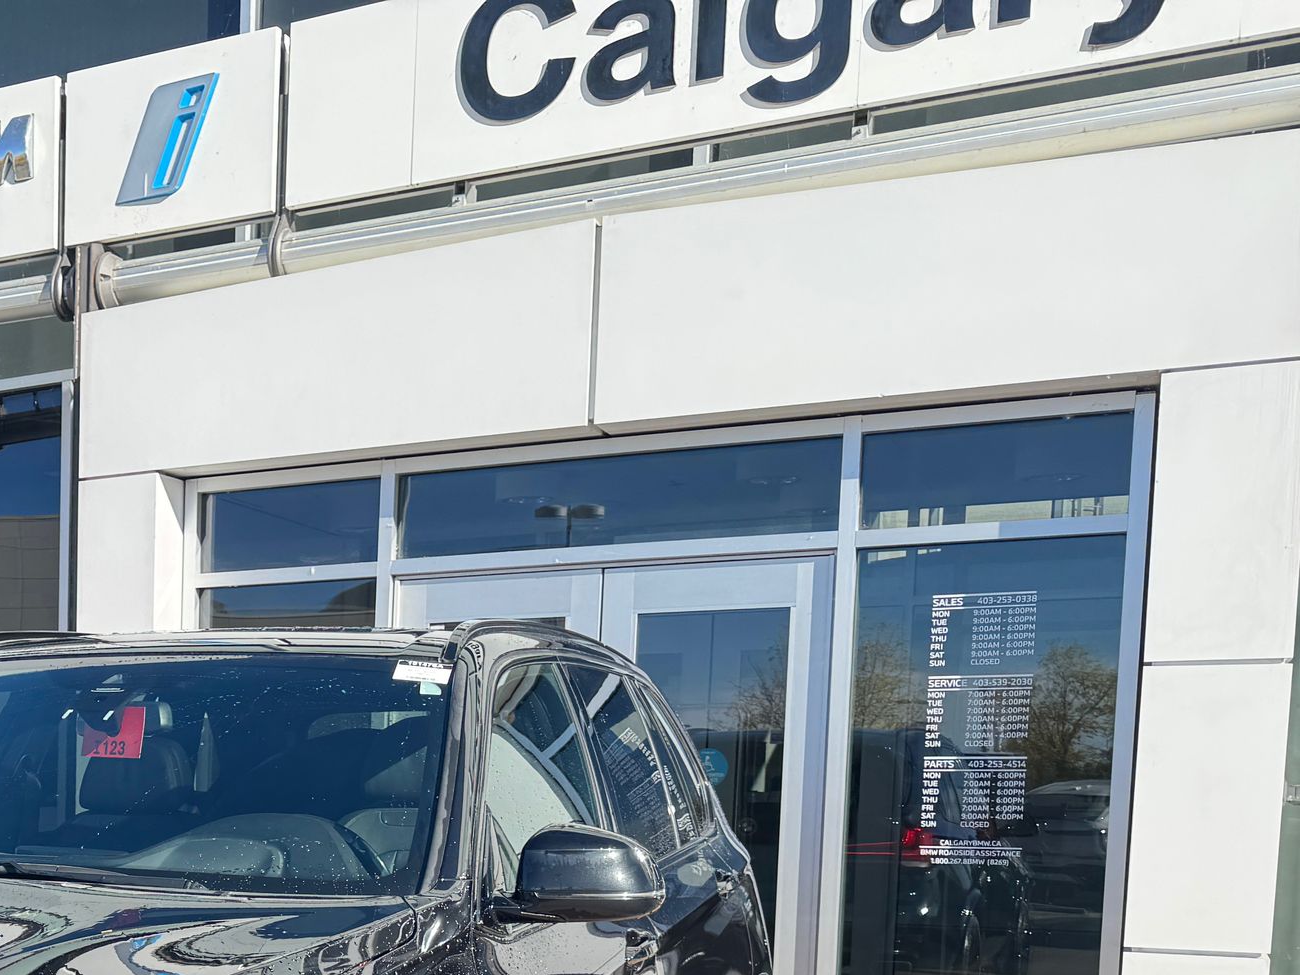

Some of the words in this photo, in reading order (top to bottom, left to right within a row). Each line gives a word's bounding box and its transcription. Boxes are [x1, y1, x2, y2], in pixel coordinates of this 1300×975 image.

[933, 598, 963, 607] SALES
[977, 595, 1037, 605] 403-253-0338
[928, 680, 968, 688] SERVICE
[940, 839, 1001, 847] CALGARYBMW.CA
[939, 849, 974, 857] ROADSIDE
